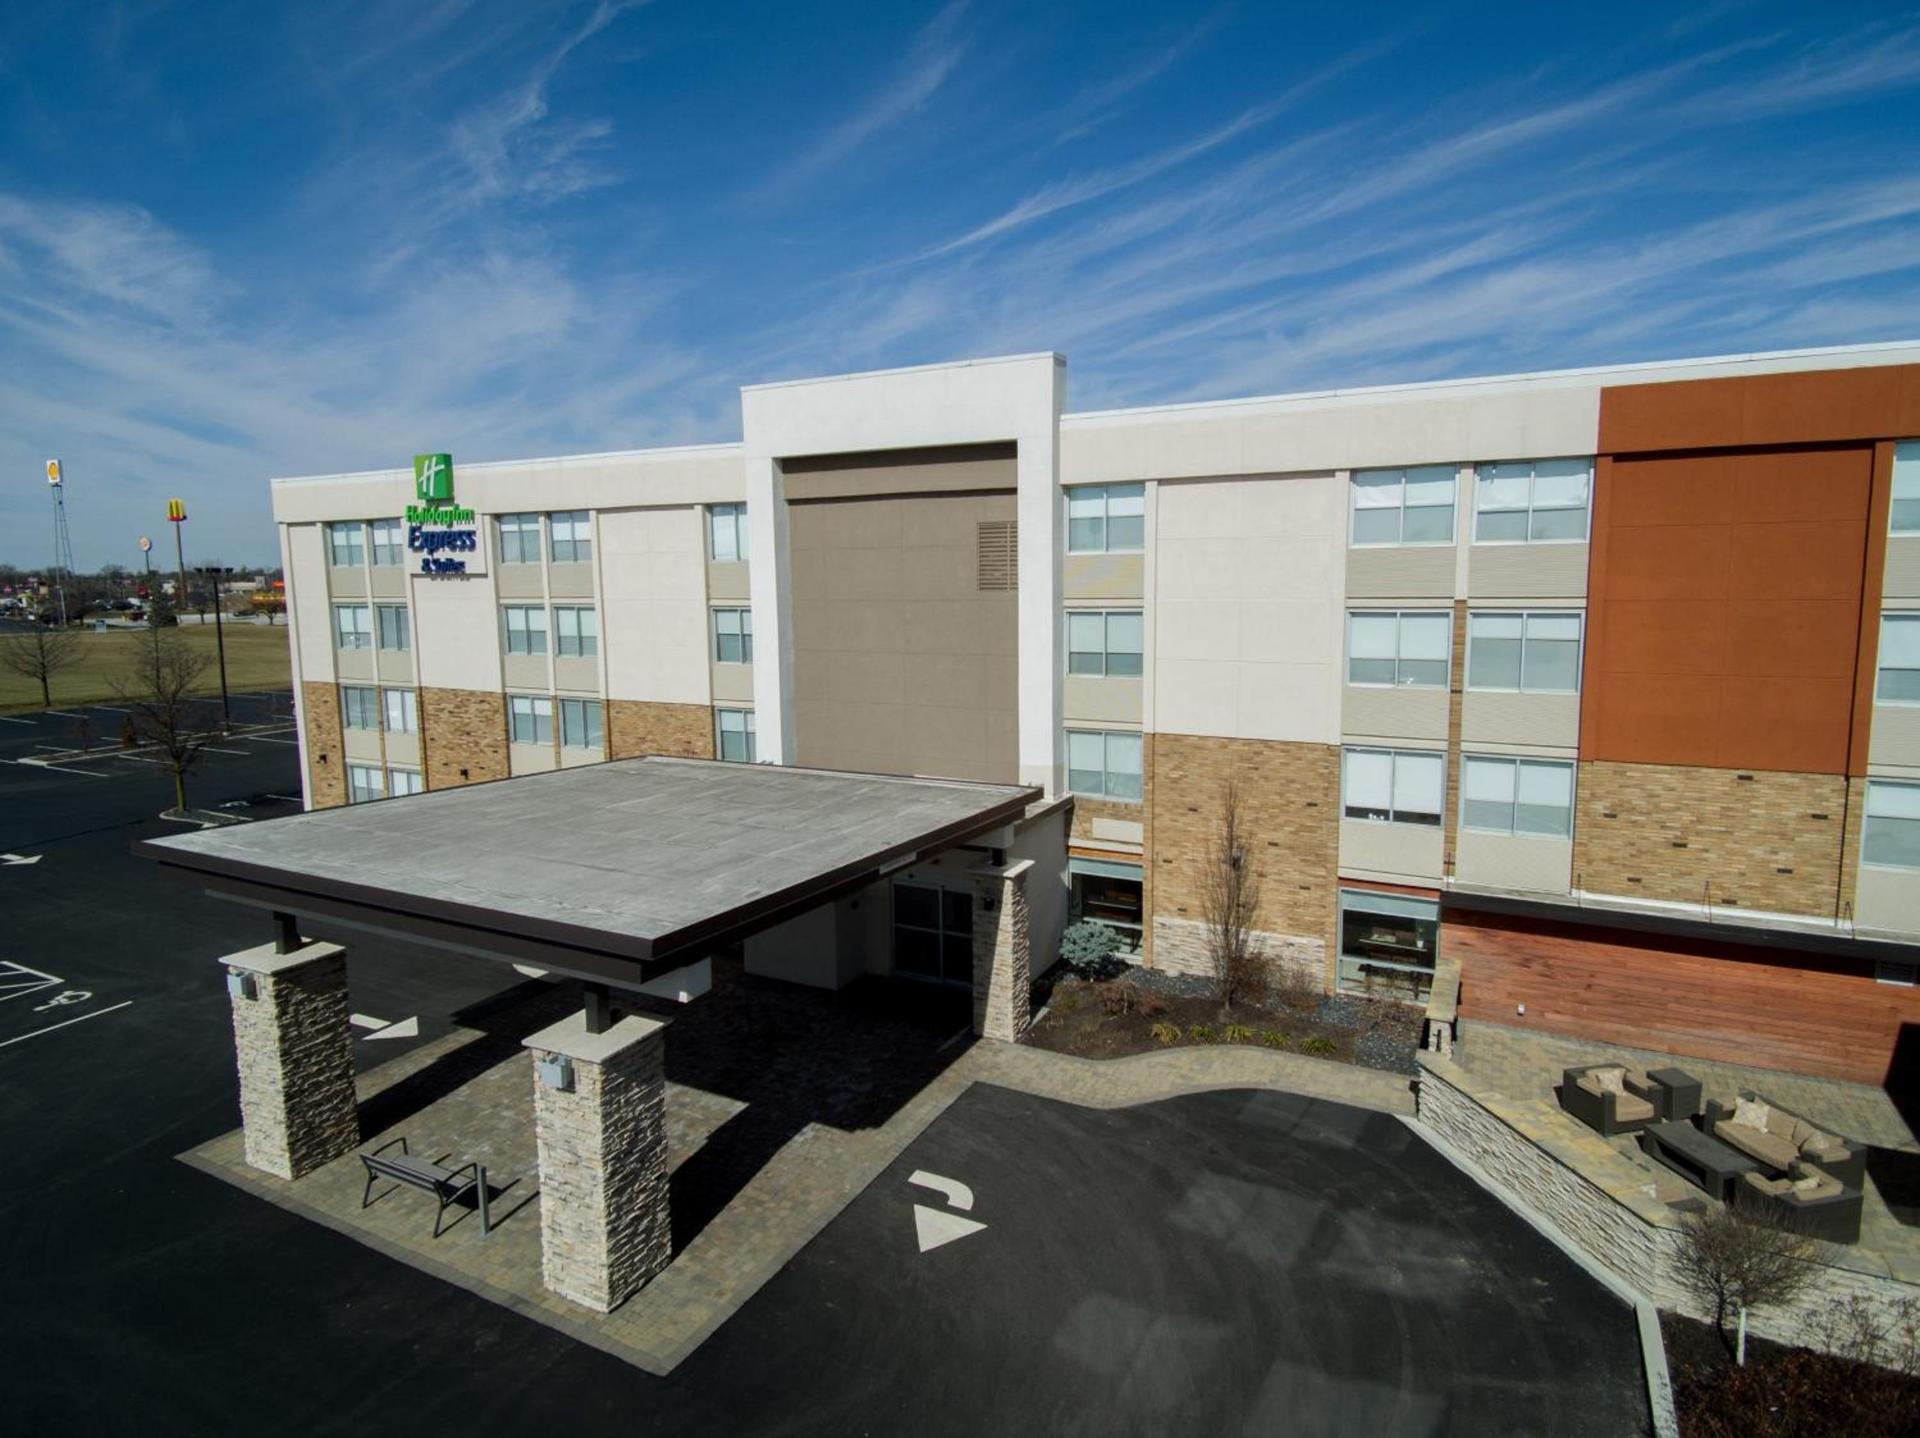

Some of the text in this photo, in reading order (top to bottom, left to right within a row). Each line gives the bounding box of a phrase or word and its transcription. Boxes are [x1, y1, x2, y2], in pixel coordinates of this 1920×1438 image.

[405, 504, 475, 527] Holiday Inn
[408, 526, 476, 555] Express
